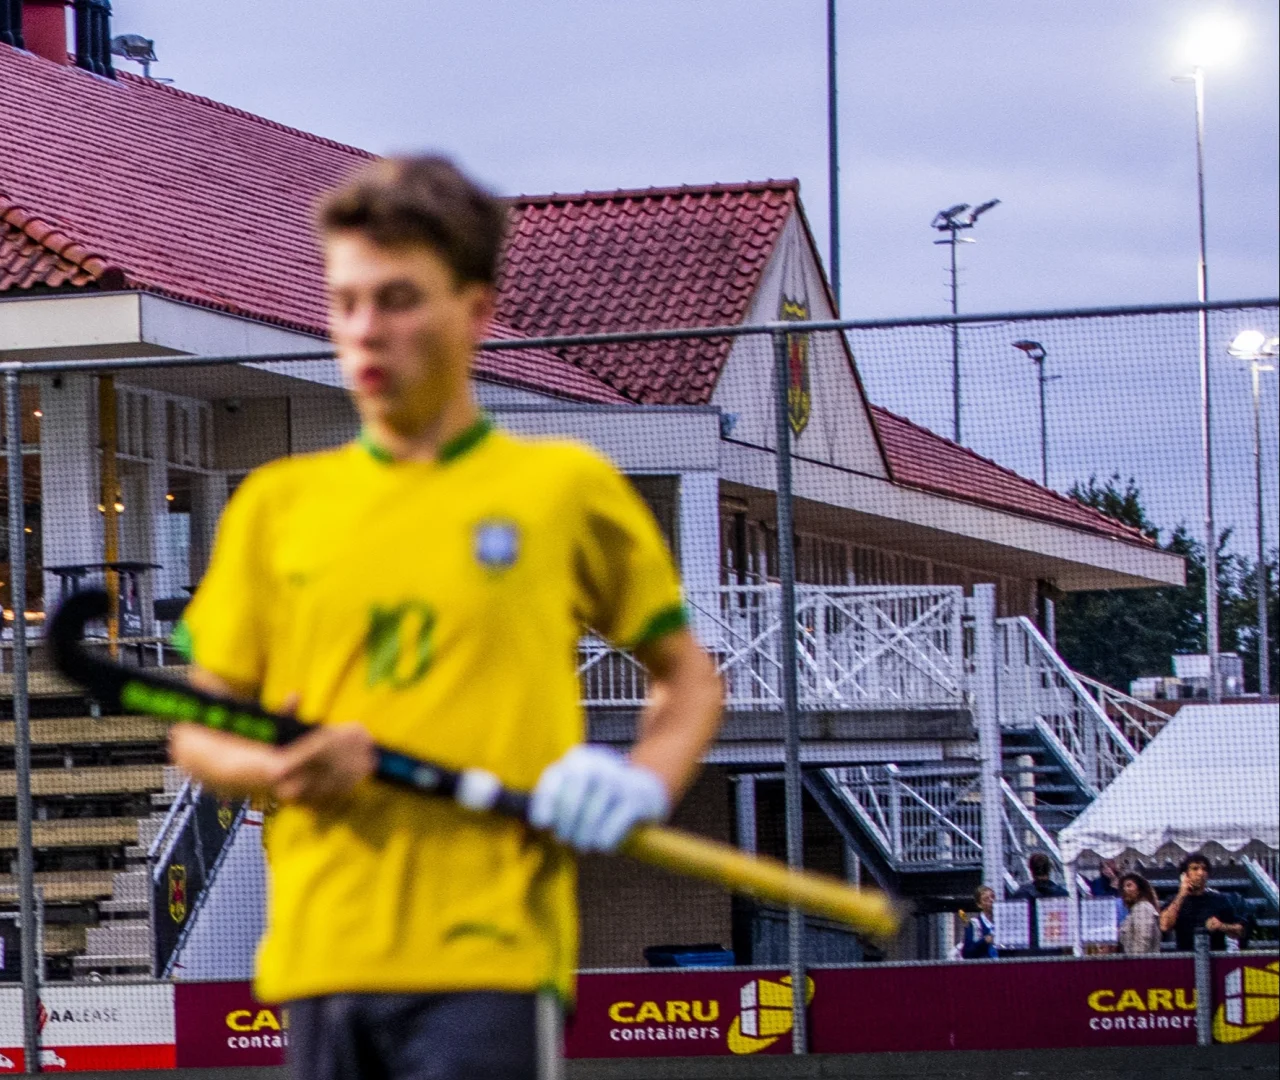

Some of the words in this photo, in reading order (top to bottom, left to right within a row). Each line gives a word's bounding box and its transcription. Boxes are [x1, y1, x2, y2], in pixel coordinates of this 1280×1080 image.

[1087, 987, 1198, 1012] CARU
[225, 1009, 290, 1031] CA
[608, 1000, 720, 1024] CARU
[227, 1032, 289, 1049] contai
[609, 1024, 721, 1042] containers
